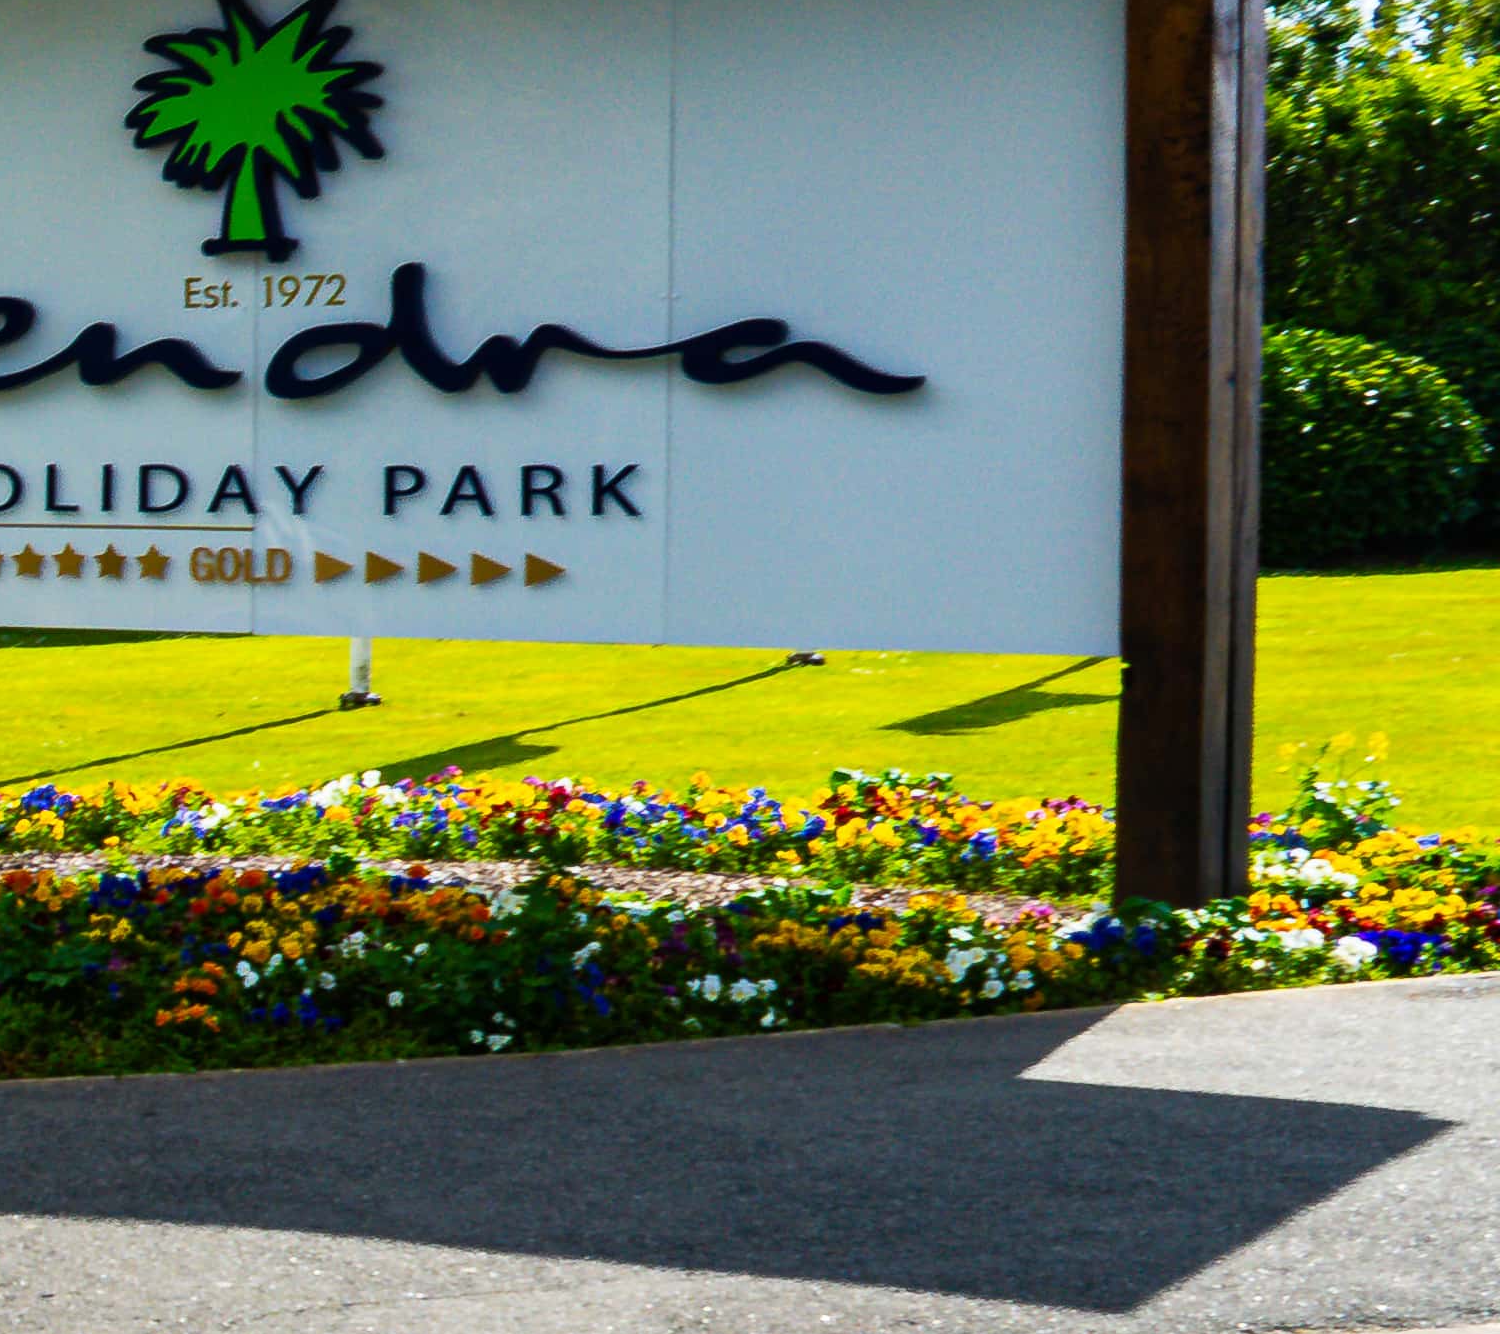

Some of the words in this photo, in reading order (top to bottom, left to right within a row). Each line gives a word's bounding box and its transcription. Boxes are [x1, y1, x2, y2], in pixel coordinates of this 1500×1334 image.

[184, 276, 238, 308] Est.
[263, 274, 347, 307] 1972
[383, 463, 643, 520] PARK
[190, 547, 292, 584] GOLD
